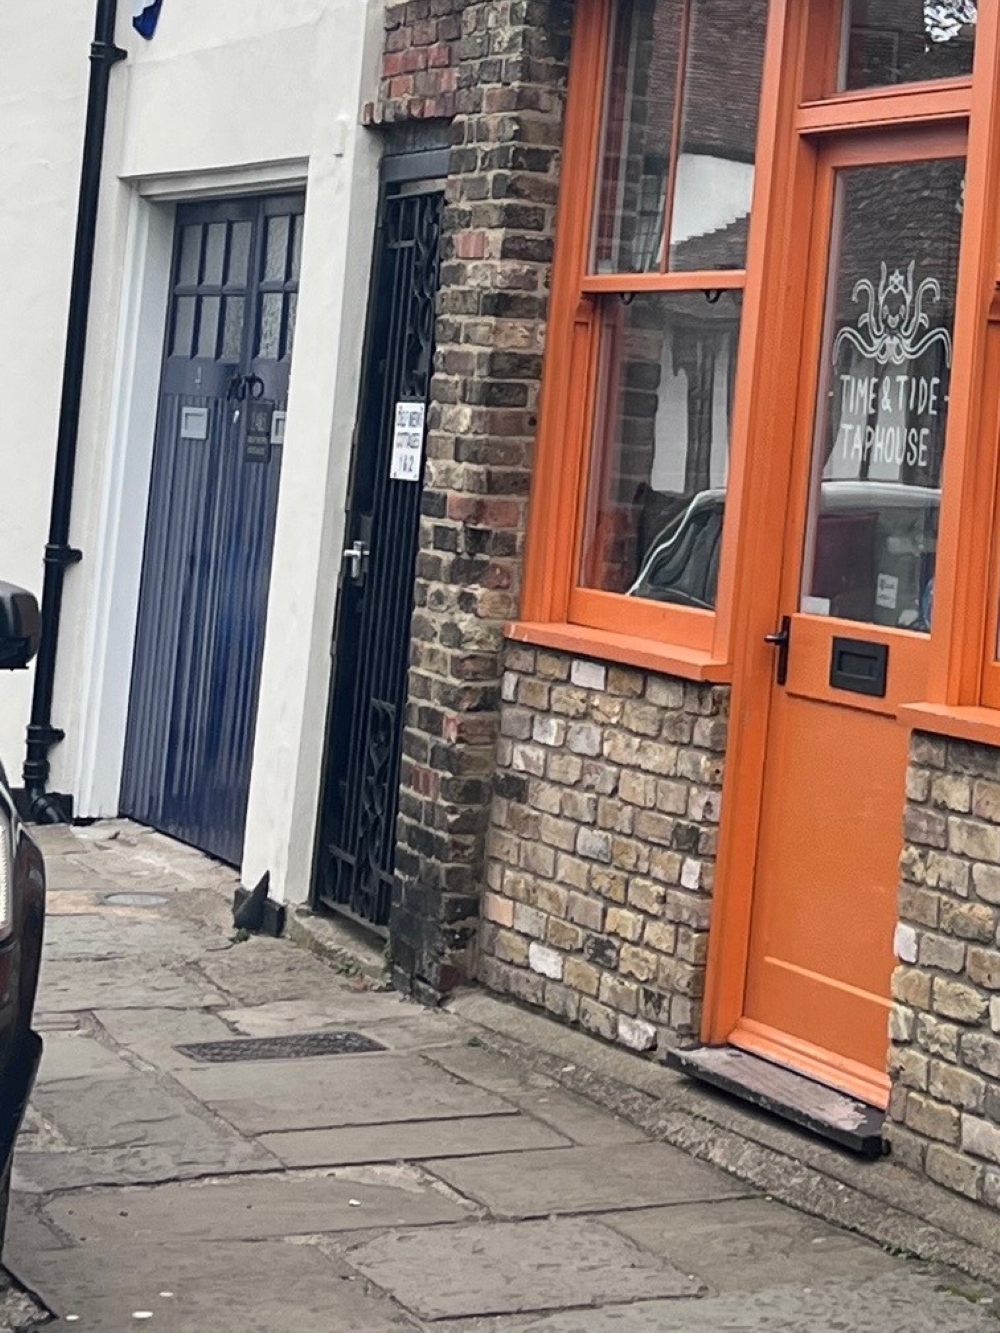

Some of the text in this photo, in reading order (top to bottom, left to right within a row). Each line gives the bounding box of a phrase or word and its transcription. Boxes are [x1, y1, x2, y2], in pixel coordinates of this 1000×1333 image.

[839, 374, 941, 416] TIME & TIDE
[841, 422, 931, 467] TAPHOUSE
